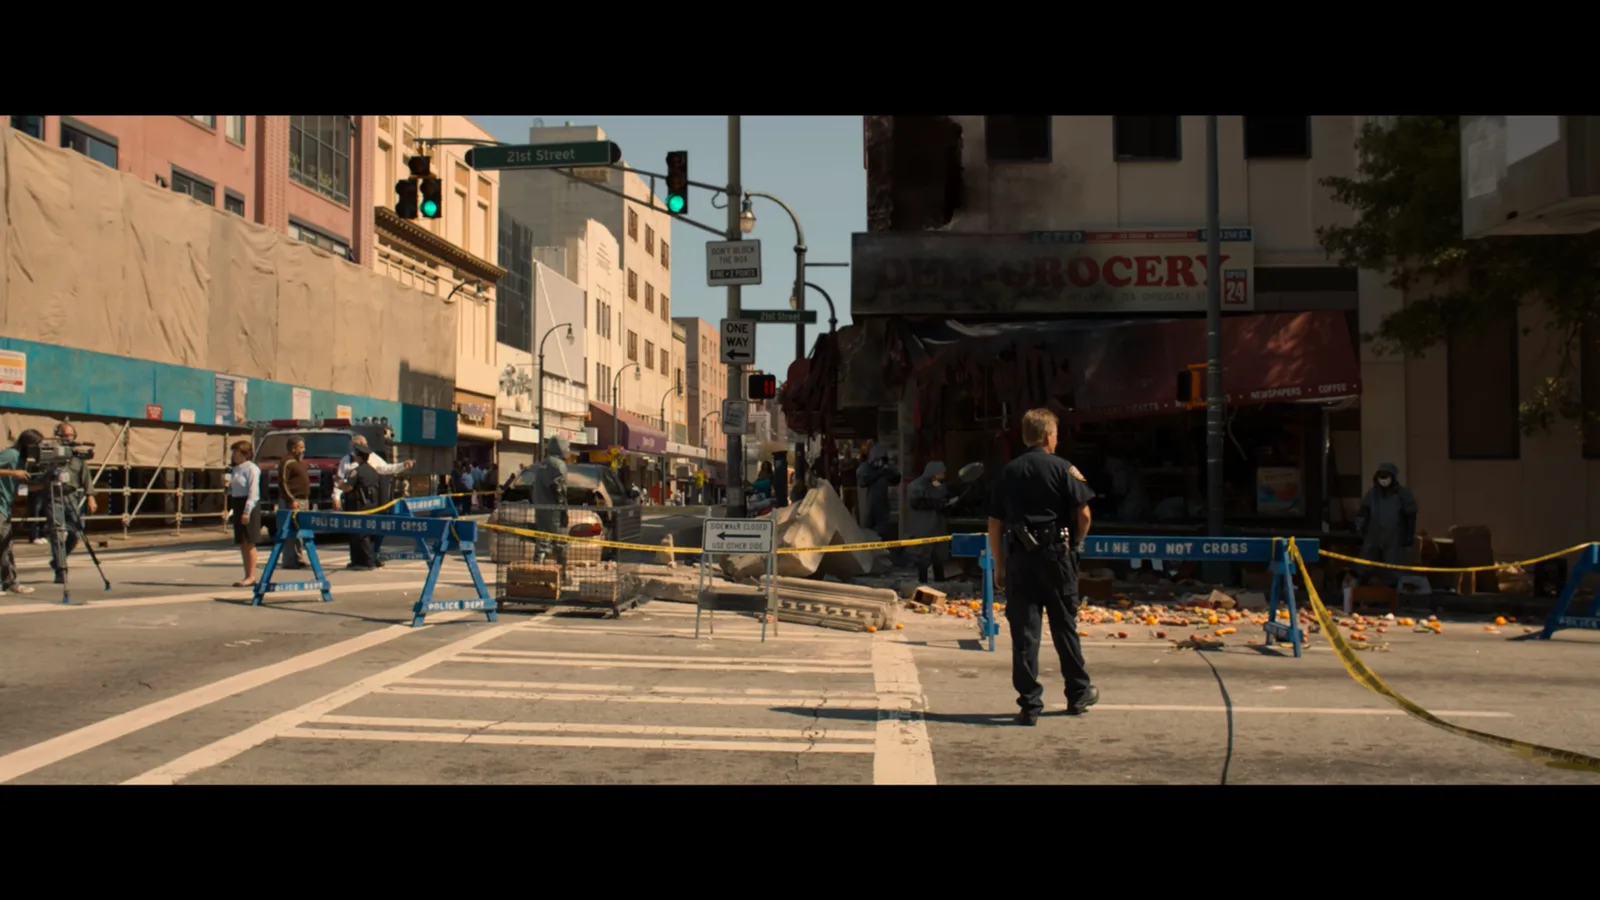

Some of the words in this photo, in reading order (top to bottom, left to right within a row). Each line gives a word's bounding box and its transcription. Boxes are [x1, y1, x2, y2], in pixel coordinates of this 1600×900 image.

[506, 150, 532, 163] 21st
[535, 148, 576, 161] Street
[733, 245, 755, 255] BLOCK
[719, 256, 733, 264] THE
[733, 256, 748, 264] BOX
[1226, 281, 1245, 302] 24
[777, 311, 801, 321] Street
[726, 323, 749, 334] ONE
[726, 336, 749, 347] WAY
[1250, 386, 1302, 400] NEWSPAPERS
[1318, 382, 1347, 394] COFFEE
[310, 516, 339, 529] POLICE
[343, 518, 362, 530] LINE
[366, 519, 377, 530] DO
[380, 520, 396, 531] NOT
[401, 520, 428, 532] CROSS
[710, 522, 741, 530] SIDEWALK
[742, 523, 768, 531] CLOSED
[1095, 541, 1130, 554] LINE
[1139, 541, 1157, 554] DO
[1166, 542, 1193, 555] NOT
[1202, 542, 1248, 555] CROSS
[428, 601, 460, 610] POLICE
[464, 600, 485, 609] DEPT
